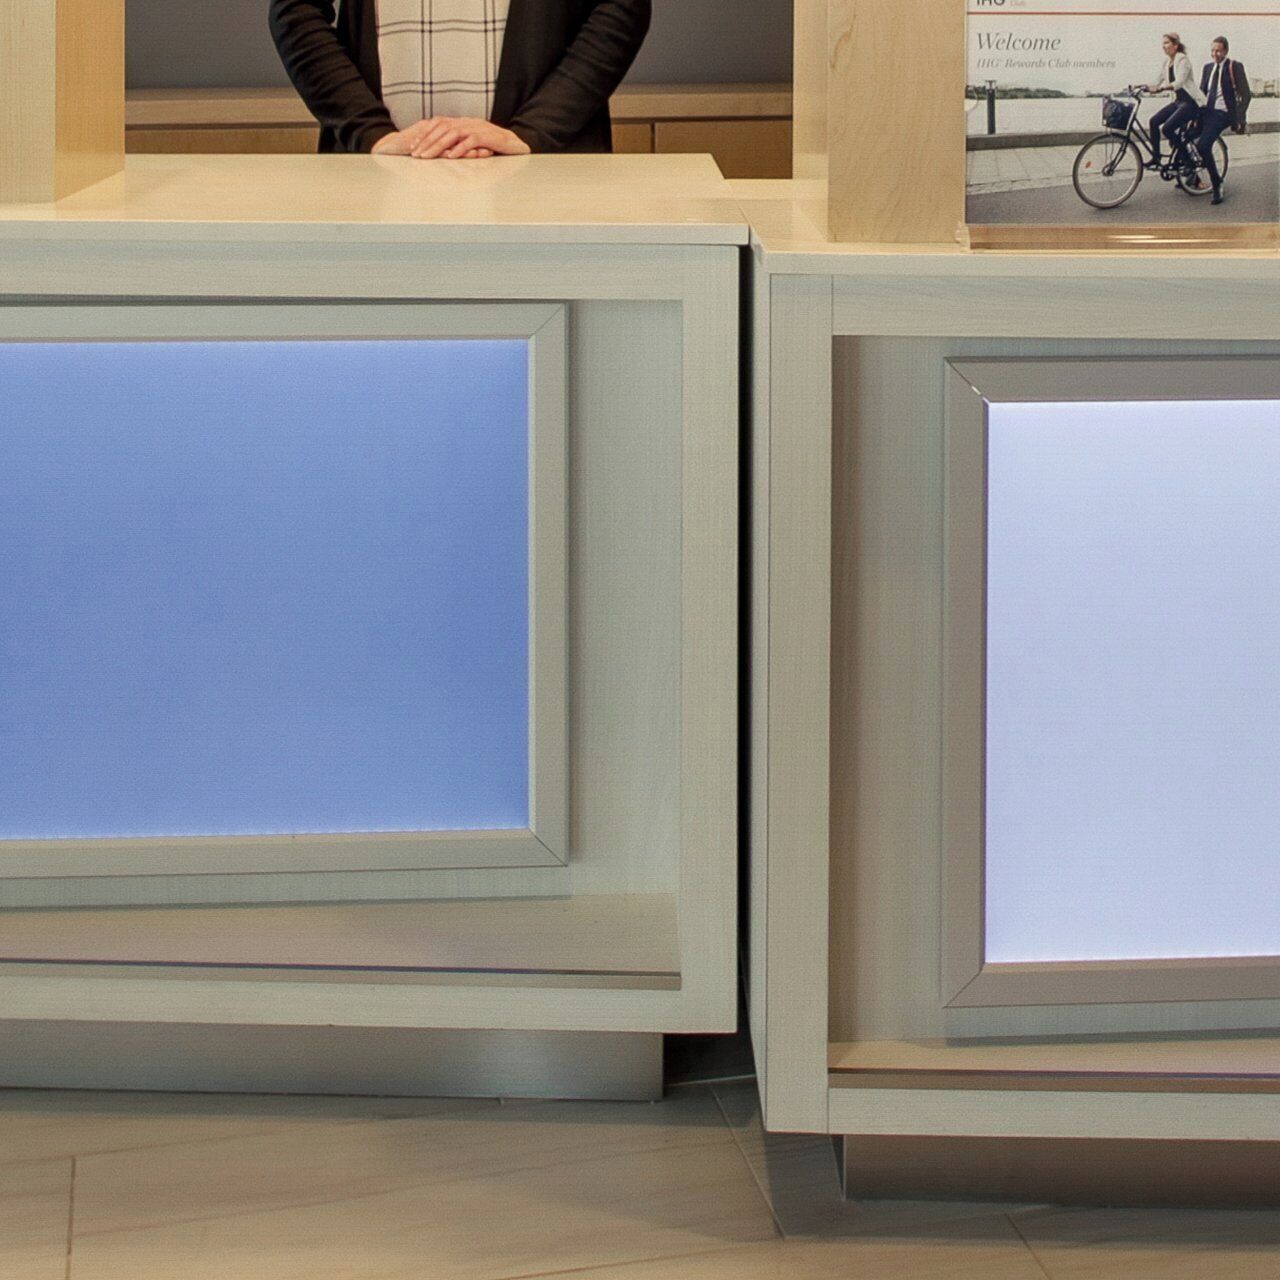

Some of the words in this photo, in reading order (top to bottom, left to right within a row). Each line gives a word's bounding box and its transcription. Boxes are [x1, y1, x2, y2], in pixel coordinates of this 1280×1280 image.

[977, 31, 1062, 51] Welcome
[1005, 58, 1046, 69] Rewards
[1048, 58, 1071, 69] Club
[1072, 58, 1117, 69] members
